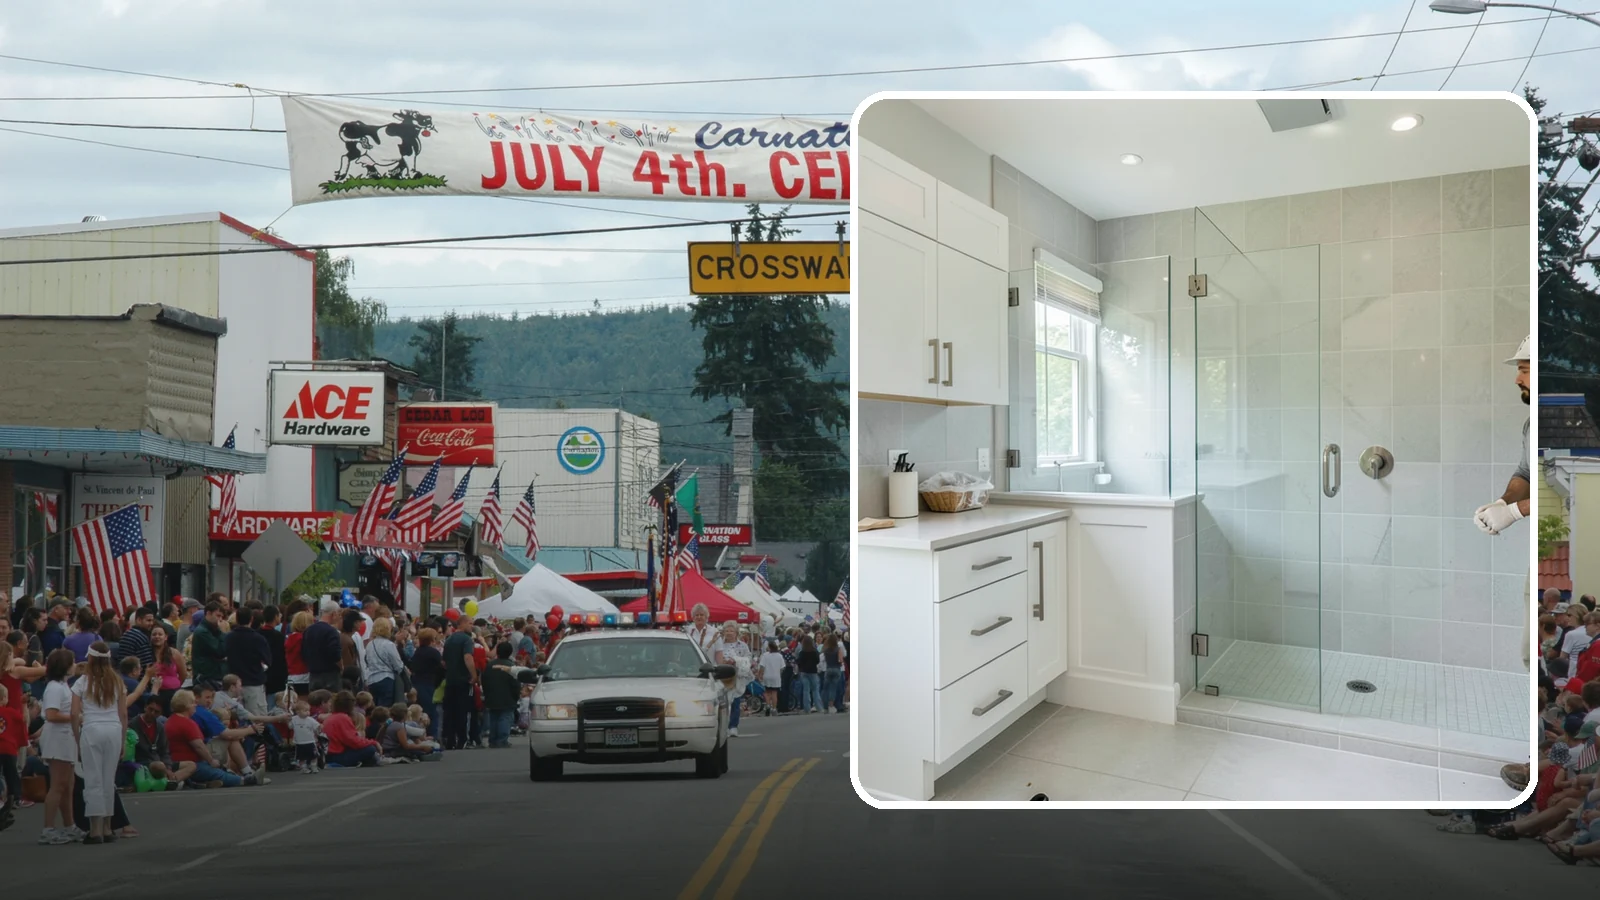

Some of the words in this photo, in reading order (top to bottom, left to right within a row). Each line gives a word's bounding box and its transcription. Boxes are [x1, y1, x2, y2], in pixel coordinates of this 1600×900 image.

[481, 141, 605, 193] JULY
[632, 150, 747, 198] 4th.
[697, 254, 850, 280] CROSSWA
[283, 380, 374, 420] ACE
[406, 409, 452, 422] CEDAR
[283, 421, 371, 436] Hardware
[416, 428, 477, 447] Coca-Cola
[96, 485, 124, 494] Vincent
[126, 486, 135, 494] de
[138, 486, 155, 495] Paul
[688, 526, 741, 535] CRNATION
[699, 535, 730, 543] GLASS
